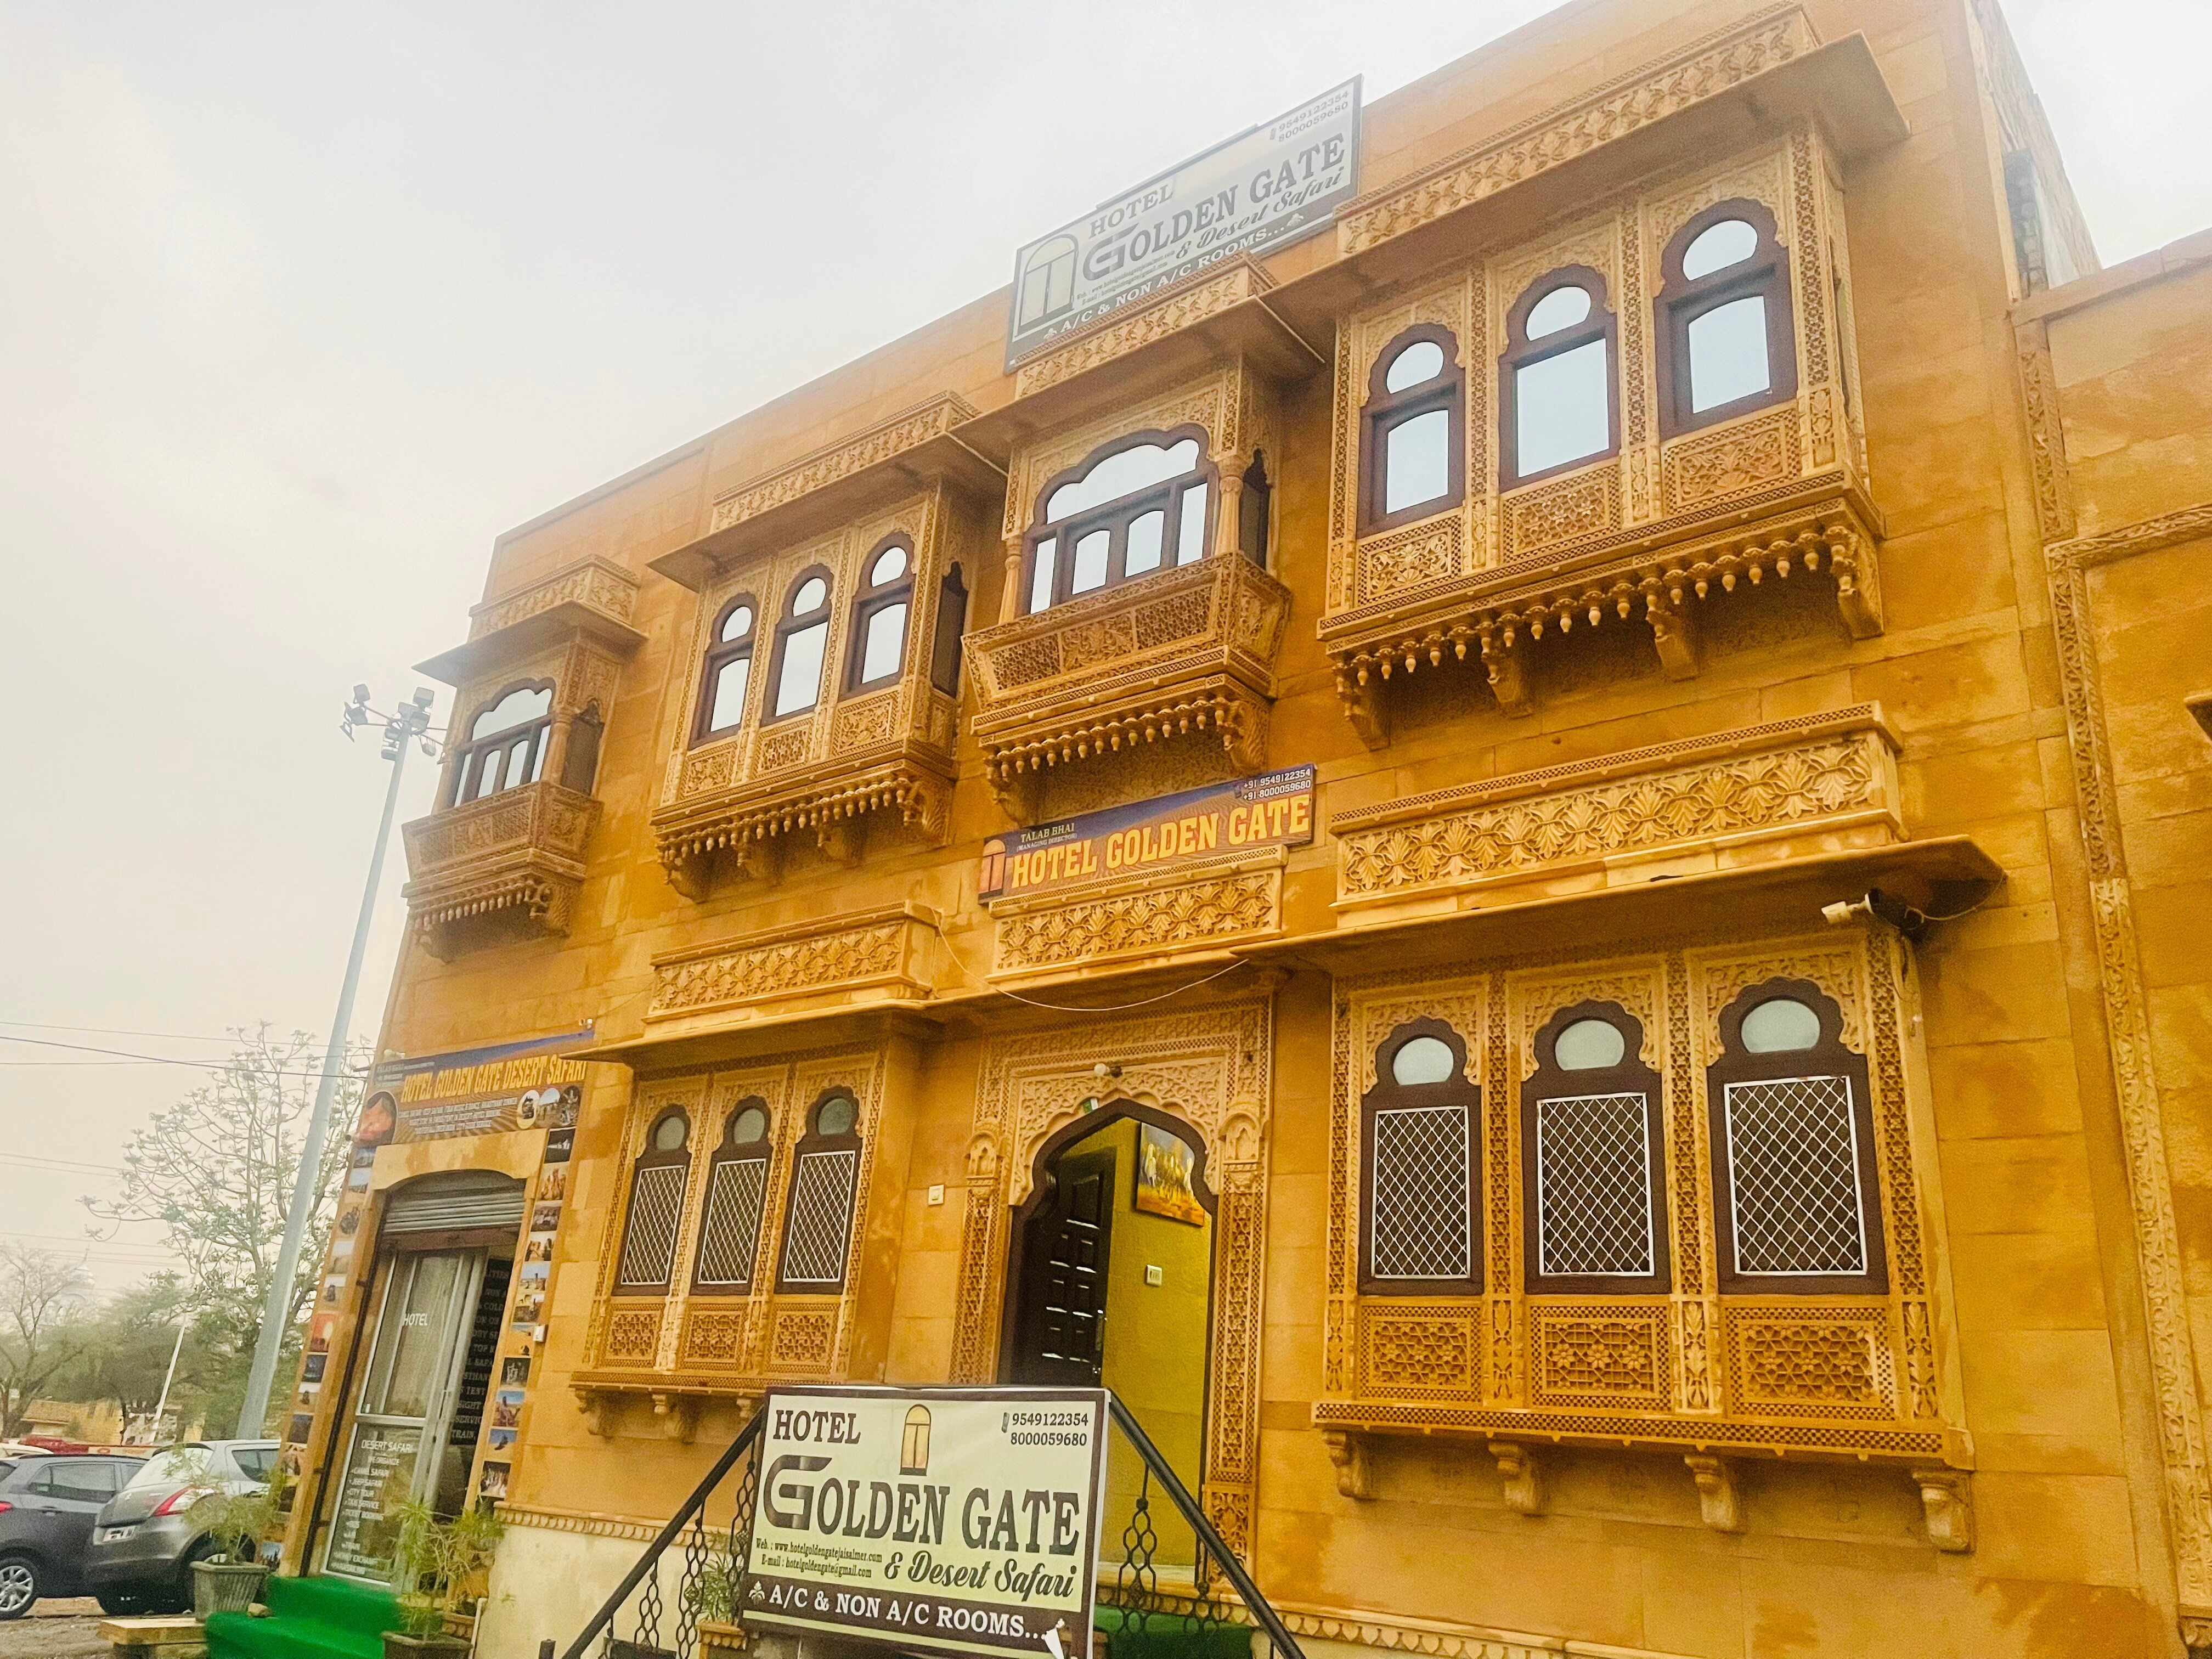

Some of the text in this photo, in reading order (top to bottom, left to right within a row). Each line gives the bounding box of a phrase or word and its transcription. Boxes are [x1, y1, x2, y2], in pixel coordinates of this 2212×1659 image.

[1279, 91, 1349, 132] 9549122354
[1279, 101, 1348, 142] 8000059680
[1082, 132, 1345, 281] GOLDEN GATE
[1088, 182, 1174, 239] HOTEL
[1176, 166, 1345, 259] & Desert Safari
[1060, 310, 1092, 333] A/C
[1097, 303, 1110, 315] &
[1115, 281, 1152, 307] NON
[1156, 263, 1192, 288] A/C
[1244, 768, 1311, 789] +91 9549122354
[1011, 794, 1310, 888] HOTEL GOLDEN GATE
[1020, 823, 1075, 843] TALAB BHAI
[400, 1072, 434, 1103] HOTEL
[433, 1066, 475, 1099] GOLDEN
[473, 1062, 504, 1093] GATE
[503, 1055, 549, 1090] DESERT
[404, 1313, 428, 1326] HOTEL
[772, 1409, 861, 1444] HOTEL
[1011, 1432, 1087, 1446] 8000059680
[1012, 1413, 1088, 1426] 9549122354
[362, 1440, 413, 1453] DESERT SAFARI
[370, 1468, 390, 1477] SAFARI
[763, 1454, 1080, 1556] GOLDEN GATE
[761, 1554, 781, 1567] E-mail
[786, 1556, 872, 1578] hotelgoldengate@gmail.com
[775, 1541, 882, 1563] www.hotelgoldengatejaisalmer.com
[884, 1550, 1077, 1602] & Desert Safari
[769, 1584, 809, 1609] A/C
[814, 1590, 830, 1612] &
[835, 1593, 881, 1618] NON
[886, 1600, 930, 1626] A/C
